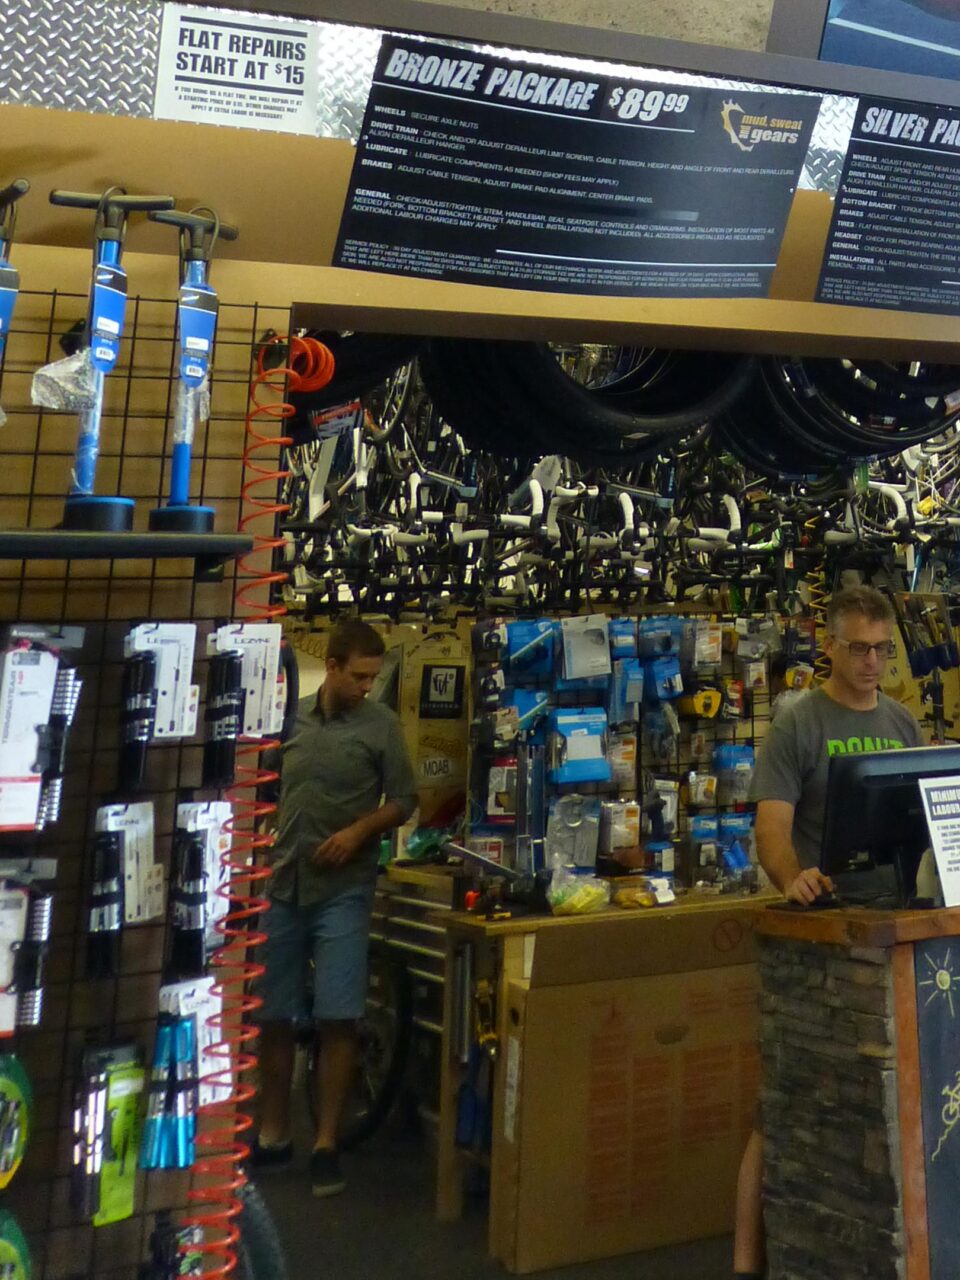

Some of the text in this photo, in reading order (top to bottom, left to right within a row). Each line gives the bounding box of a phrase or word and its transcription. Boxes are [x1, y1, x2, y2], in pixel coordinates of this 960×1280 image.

[179, 27, 306, 61] FLAT REPAIRS
[176, 51, 304, 85] START AT $15
[384, 48, 484, 91] BRONZE
[484, 68, 599, 111] PACKAGE
[373, 105, 479, 129] WHEELS SECURE AXLE NUTS
[770, 118, 803, 130] sweat
[862, 107, 930, 141] SILVER
[368, 128, 390, 138] ALIGN
[391, 132, 434, 145] DERAILLEUR
[370, 120, 393, 130] DRIVE
[395, 124, 418, 134] TRAIN
[423, 129, 447, 139] CHECK
[477, 138, 504, 148] ADJUST
[505, 143, 546, 155] DERAILLEUR
[750, 129, 799, 144] gears
[365, 143, 408, 155] LUBRICATE
[414, 151, 453, 163] LUBRICATE
[454, 157, 503, 171] COMPONENTS
[514, 166, 542, 176] NEEDED
[581, 175, 595, 183] MAY
[852, 154, 877, 162] WHEELS
[361, 158, 392, 169] BRAKES
[397, 164, 424, 174] ADJUST
[426, 169, 449, 178] CABLE
[483, 177, 510, 187] ADJUST
[511, 181, 533, 190] BRAKE
[588, 191, 614, 199] CENTER
[355, 188, 391, 199] GENERAL
[844, 187, 877, 196] LUBRICATE
[353, 196, 382, 206] NEEDED
[407, 204, 437, 214] BOTTOM
[842, 198, 896, 209] BOTTOM BRACKET
[351, 204, 497, 229] ADDITIONAL LABOUR CHARGES MAY APPLY
[839, 209, 863, 217] BRAKES
[832, 242, 860, 250] GENERAL
[829, 254, 874, 263] INSTALLATIONS
[423, 759, 449, 777] MOAB
[932, 804, 960, 815] LABOUR
